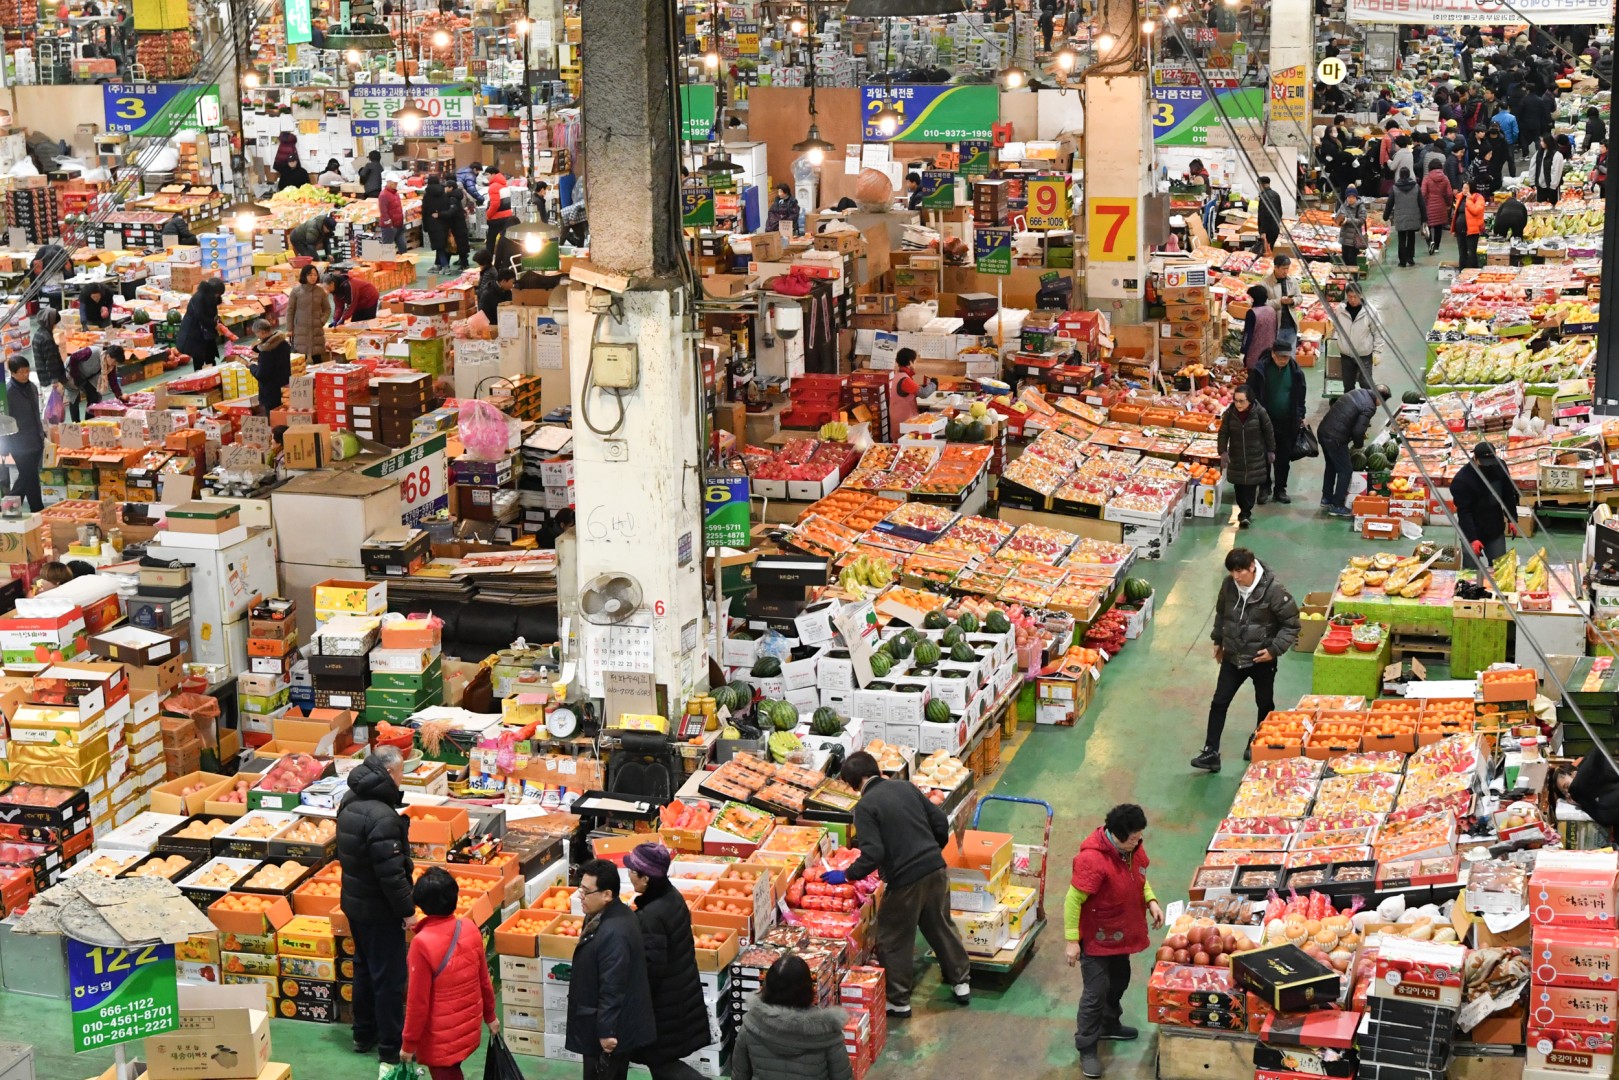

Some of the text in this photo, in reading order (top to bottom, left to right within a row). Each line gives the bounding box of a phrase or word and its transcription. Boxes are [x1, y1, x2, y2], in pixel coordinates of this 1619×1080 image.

[1323, 63, 1341, 79] 마
[116, 97, 147, 119] 3
[1153, 103, 1175, 127] 3
[923, 129, 993, 137] 010-9373-1996
[970, 146, 979, 154] 9
[933, 178, 943, 187] 7
[686, 194, 706, 204] 52
[1036, 185, 1057, 215] 9
[1029, 216, 1064, 226] 666-1009
[1096, 205, 1129, 252] 7
[984, 235, 1003, 246] 17
[406, 465, 430, 504] 68
[705, 486, 732, 502] 6
[655, 600, 665, 615] 6
[86, 945, 159, 974] 122
[88, 981, 112, 994] 농협
[100, 998, 154, 1018] 666-1122
[83, 1005, 172, 1033] 010-4561-8701
[83, 1018, 173, 1046] 010-2641-2221
